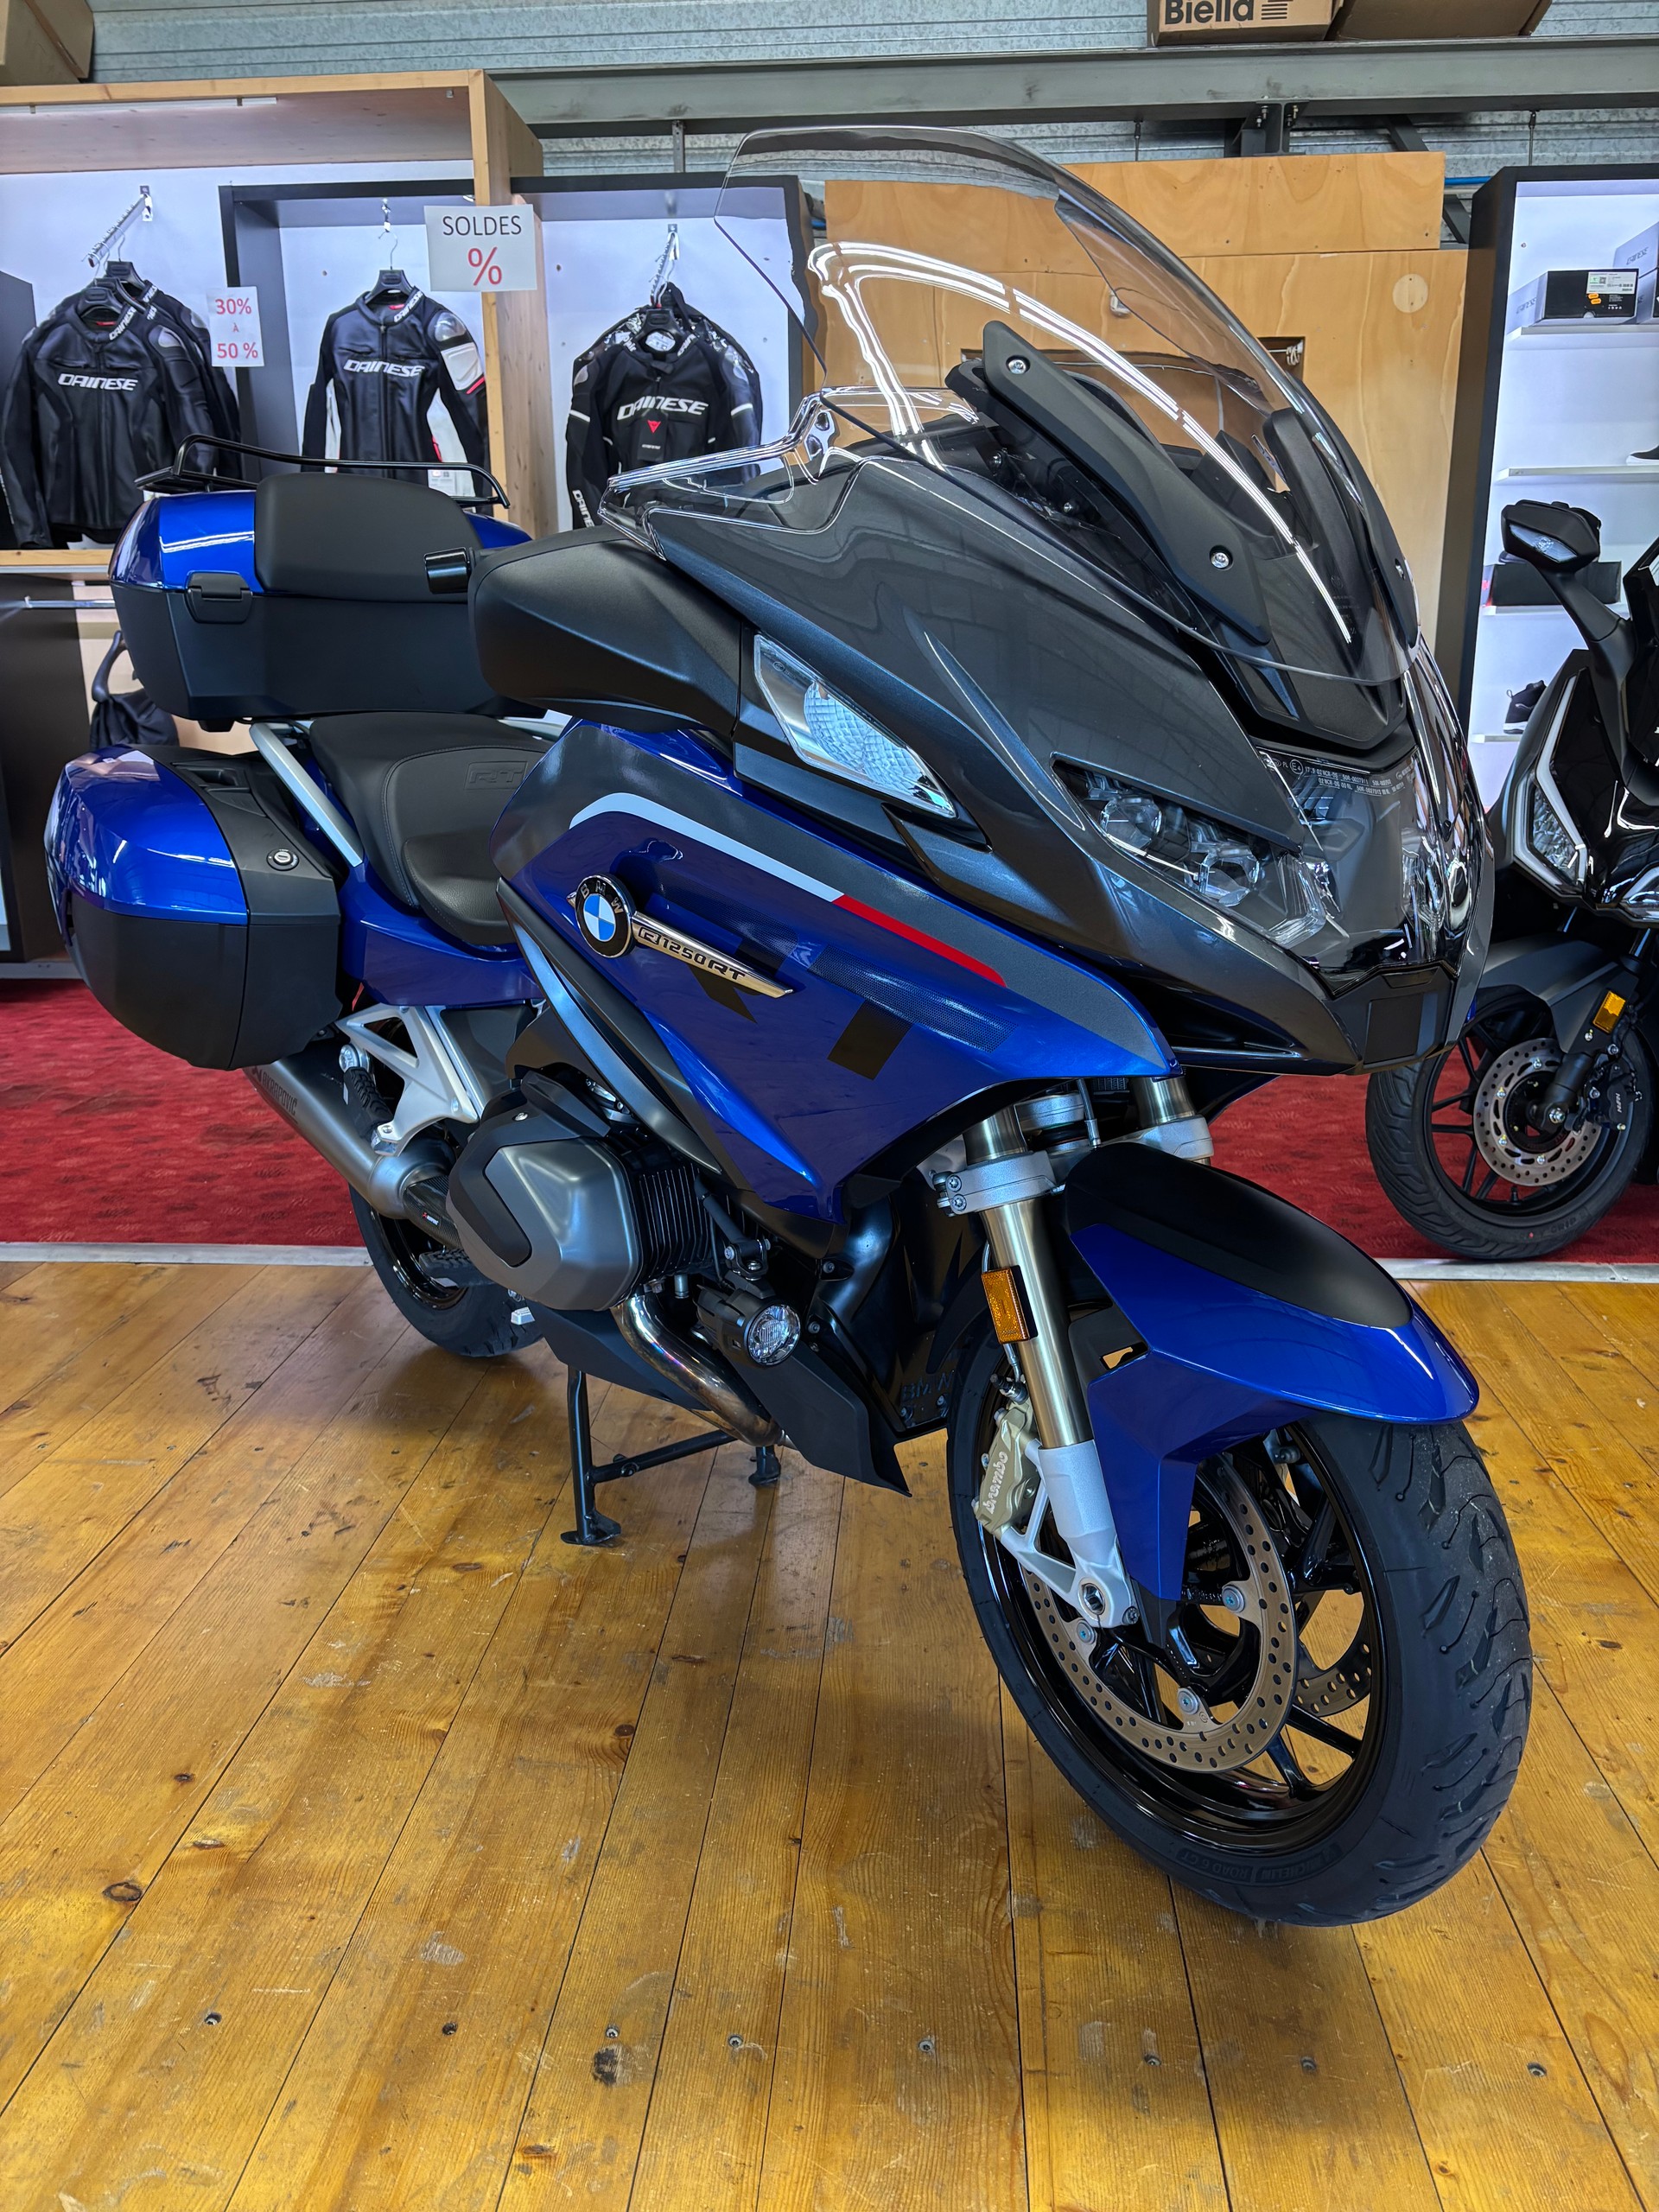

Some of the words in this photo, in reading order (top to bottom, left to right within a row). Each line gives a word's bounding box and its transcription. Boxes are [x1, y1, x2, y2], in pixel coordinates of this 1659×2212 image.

[1165, 0, 1254, 24] Biella
[442, 215, 522, 236] SOLDES
[467, 246, 503, 286] %
[215, 297, 252, 315] 30%
[217, 343, 238, 359] 50
[243, 342, 258, 359] %
[344, 359, 425, 378] DAINESE
[58, 372, 138, 391] DAINESE
[617, 395, 709, 421] DAINESE
[572, 489, 595, 528] DAINE
[581, 880, 624, 914] BMW
[983, 1452, 1008, 1515] brembo
[1212, 1862, 1248, 1878] ROAD
